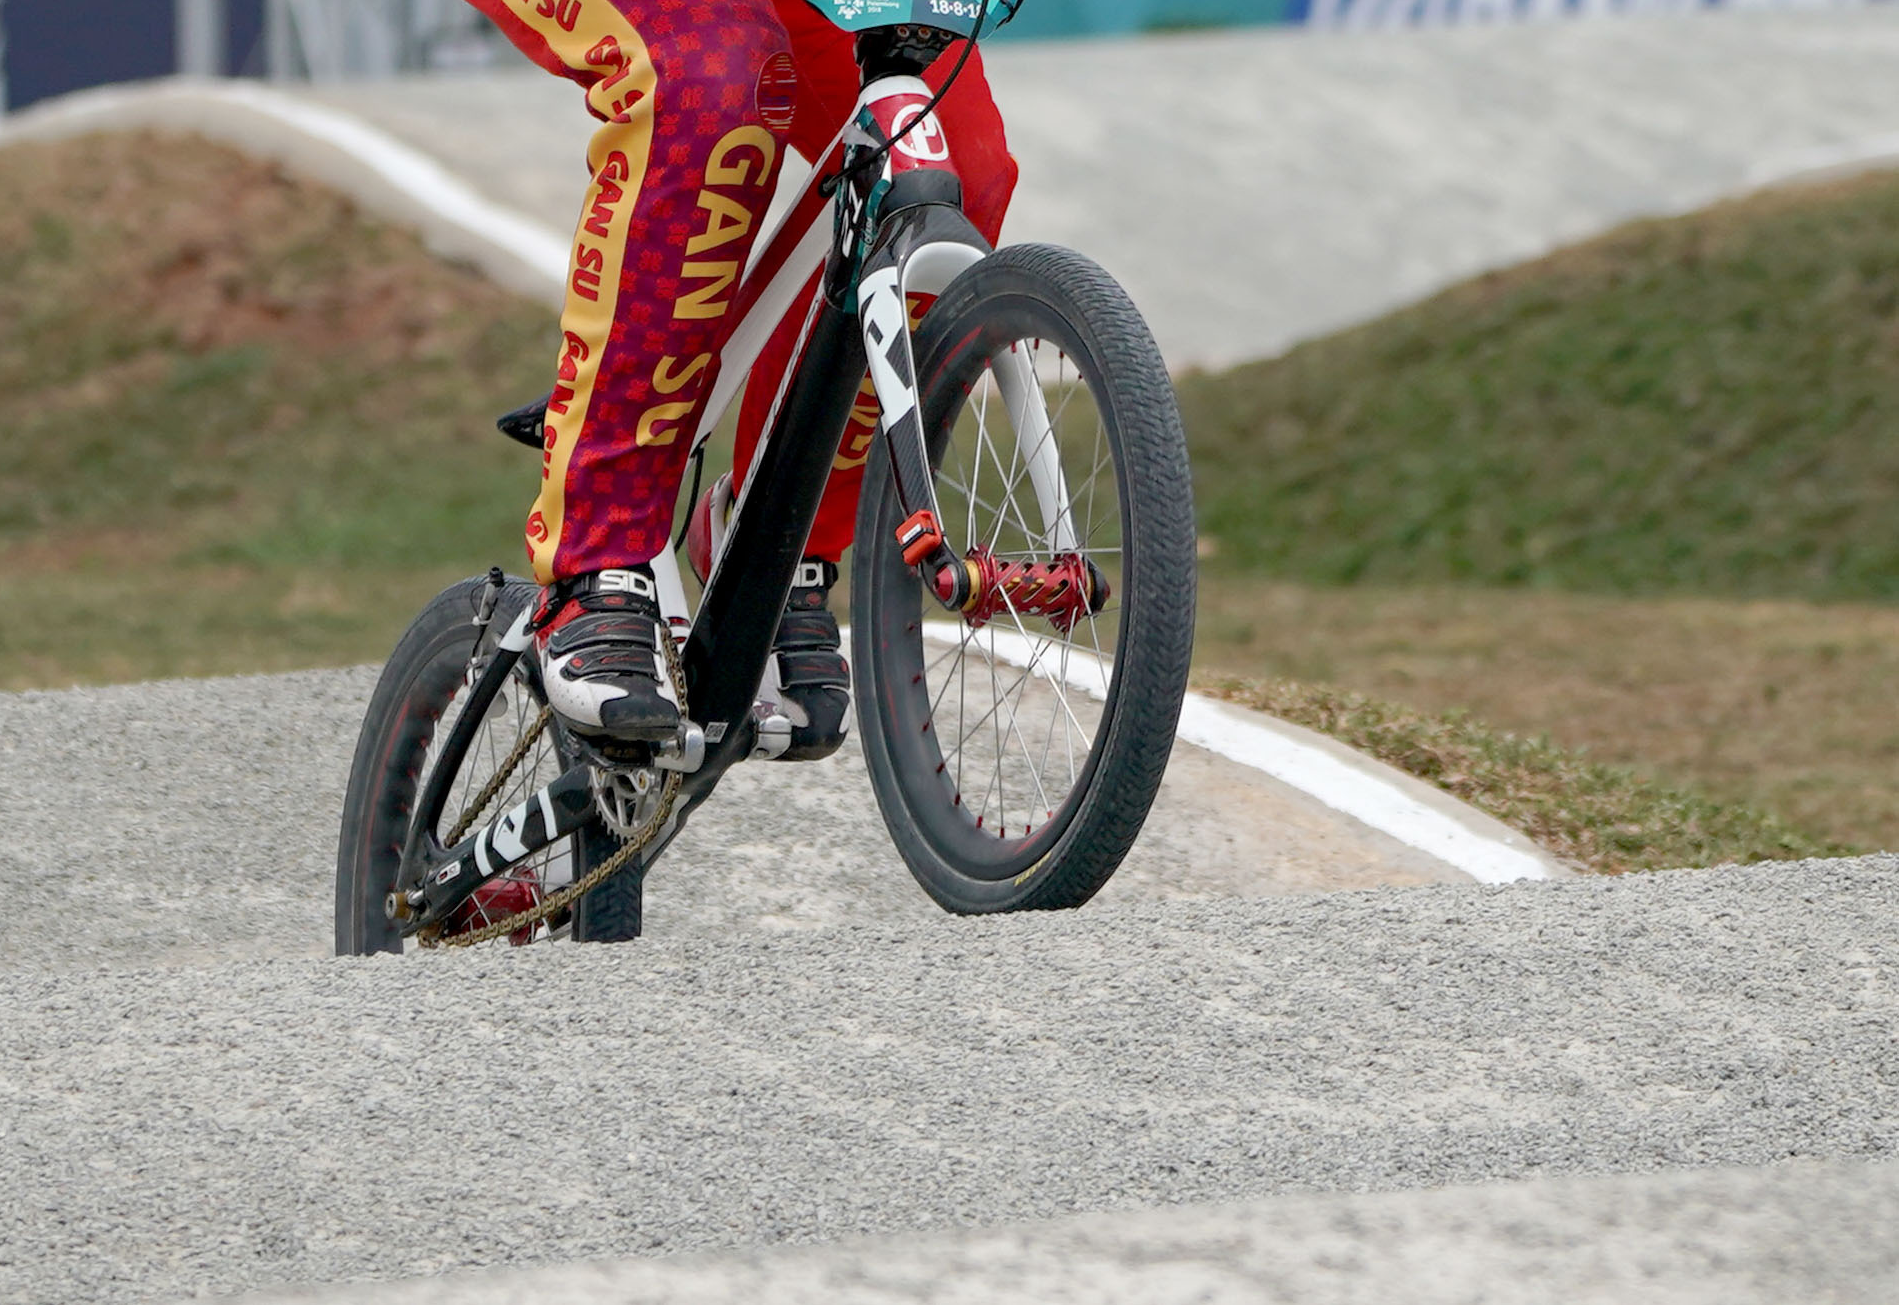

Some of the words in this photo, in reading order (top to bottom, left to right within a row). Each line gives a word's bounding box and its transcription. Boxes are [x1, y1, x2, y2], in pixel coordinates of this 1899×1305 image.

[583, 150, 630, 239] GAN
[672, 124, 777, 320] GAN
[571, 242, 604, 303] SU
[545, 330, 591, 417] GAN
[635, 351, 713, 448] SU
